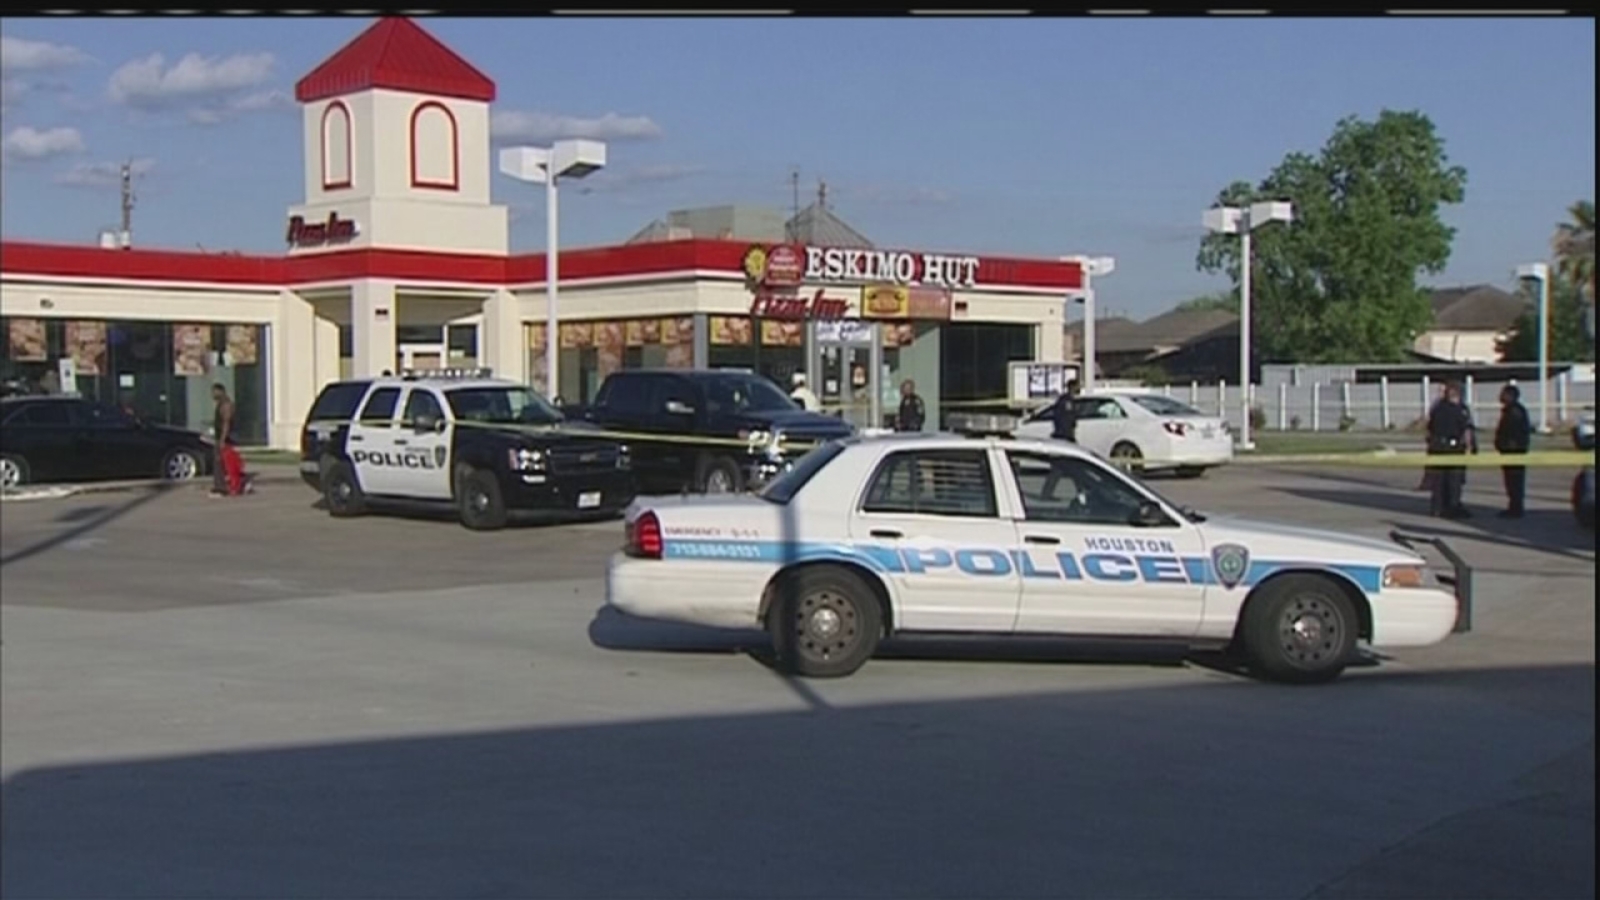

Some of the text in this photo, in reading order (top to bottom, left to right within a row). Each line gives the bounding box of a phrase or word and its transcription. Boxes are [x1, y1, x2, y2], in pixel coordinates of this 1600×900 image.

[805, 247, 915, 282] ESKIMO
[922, 255, 979, 286] HUT
[1085, 537, 1175, 553] HOUSTON
[901, 549, 1187, 584] POLICE
